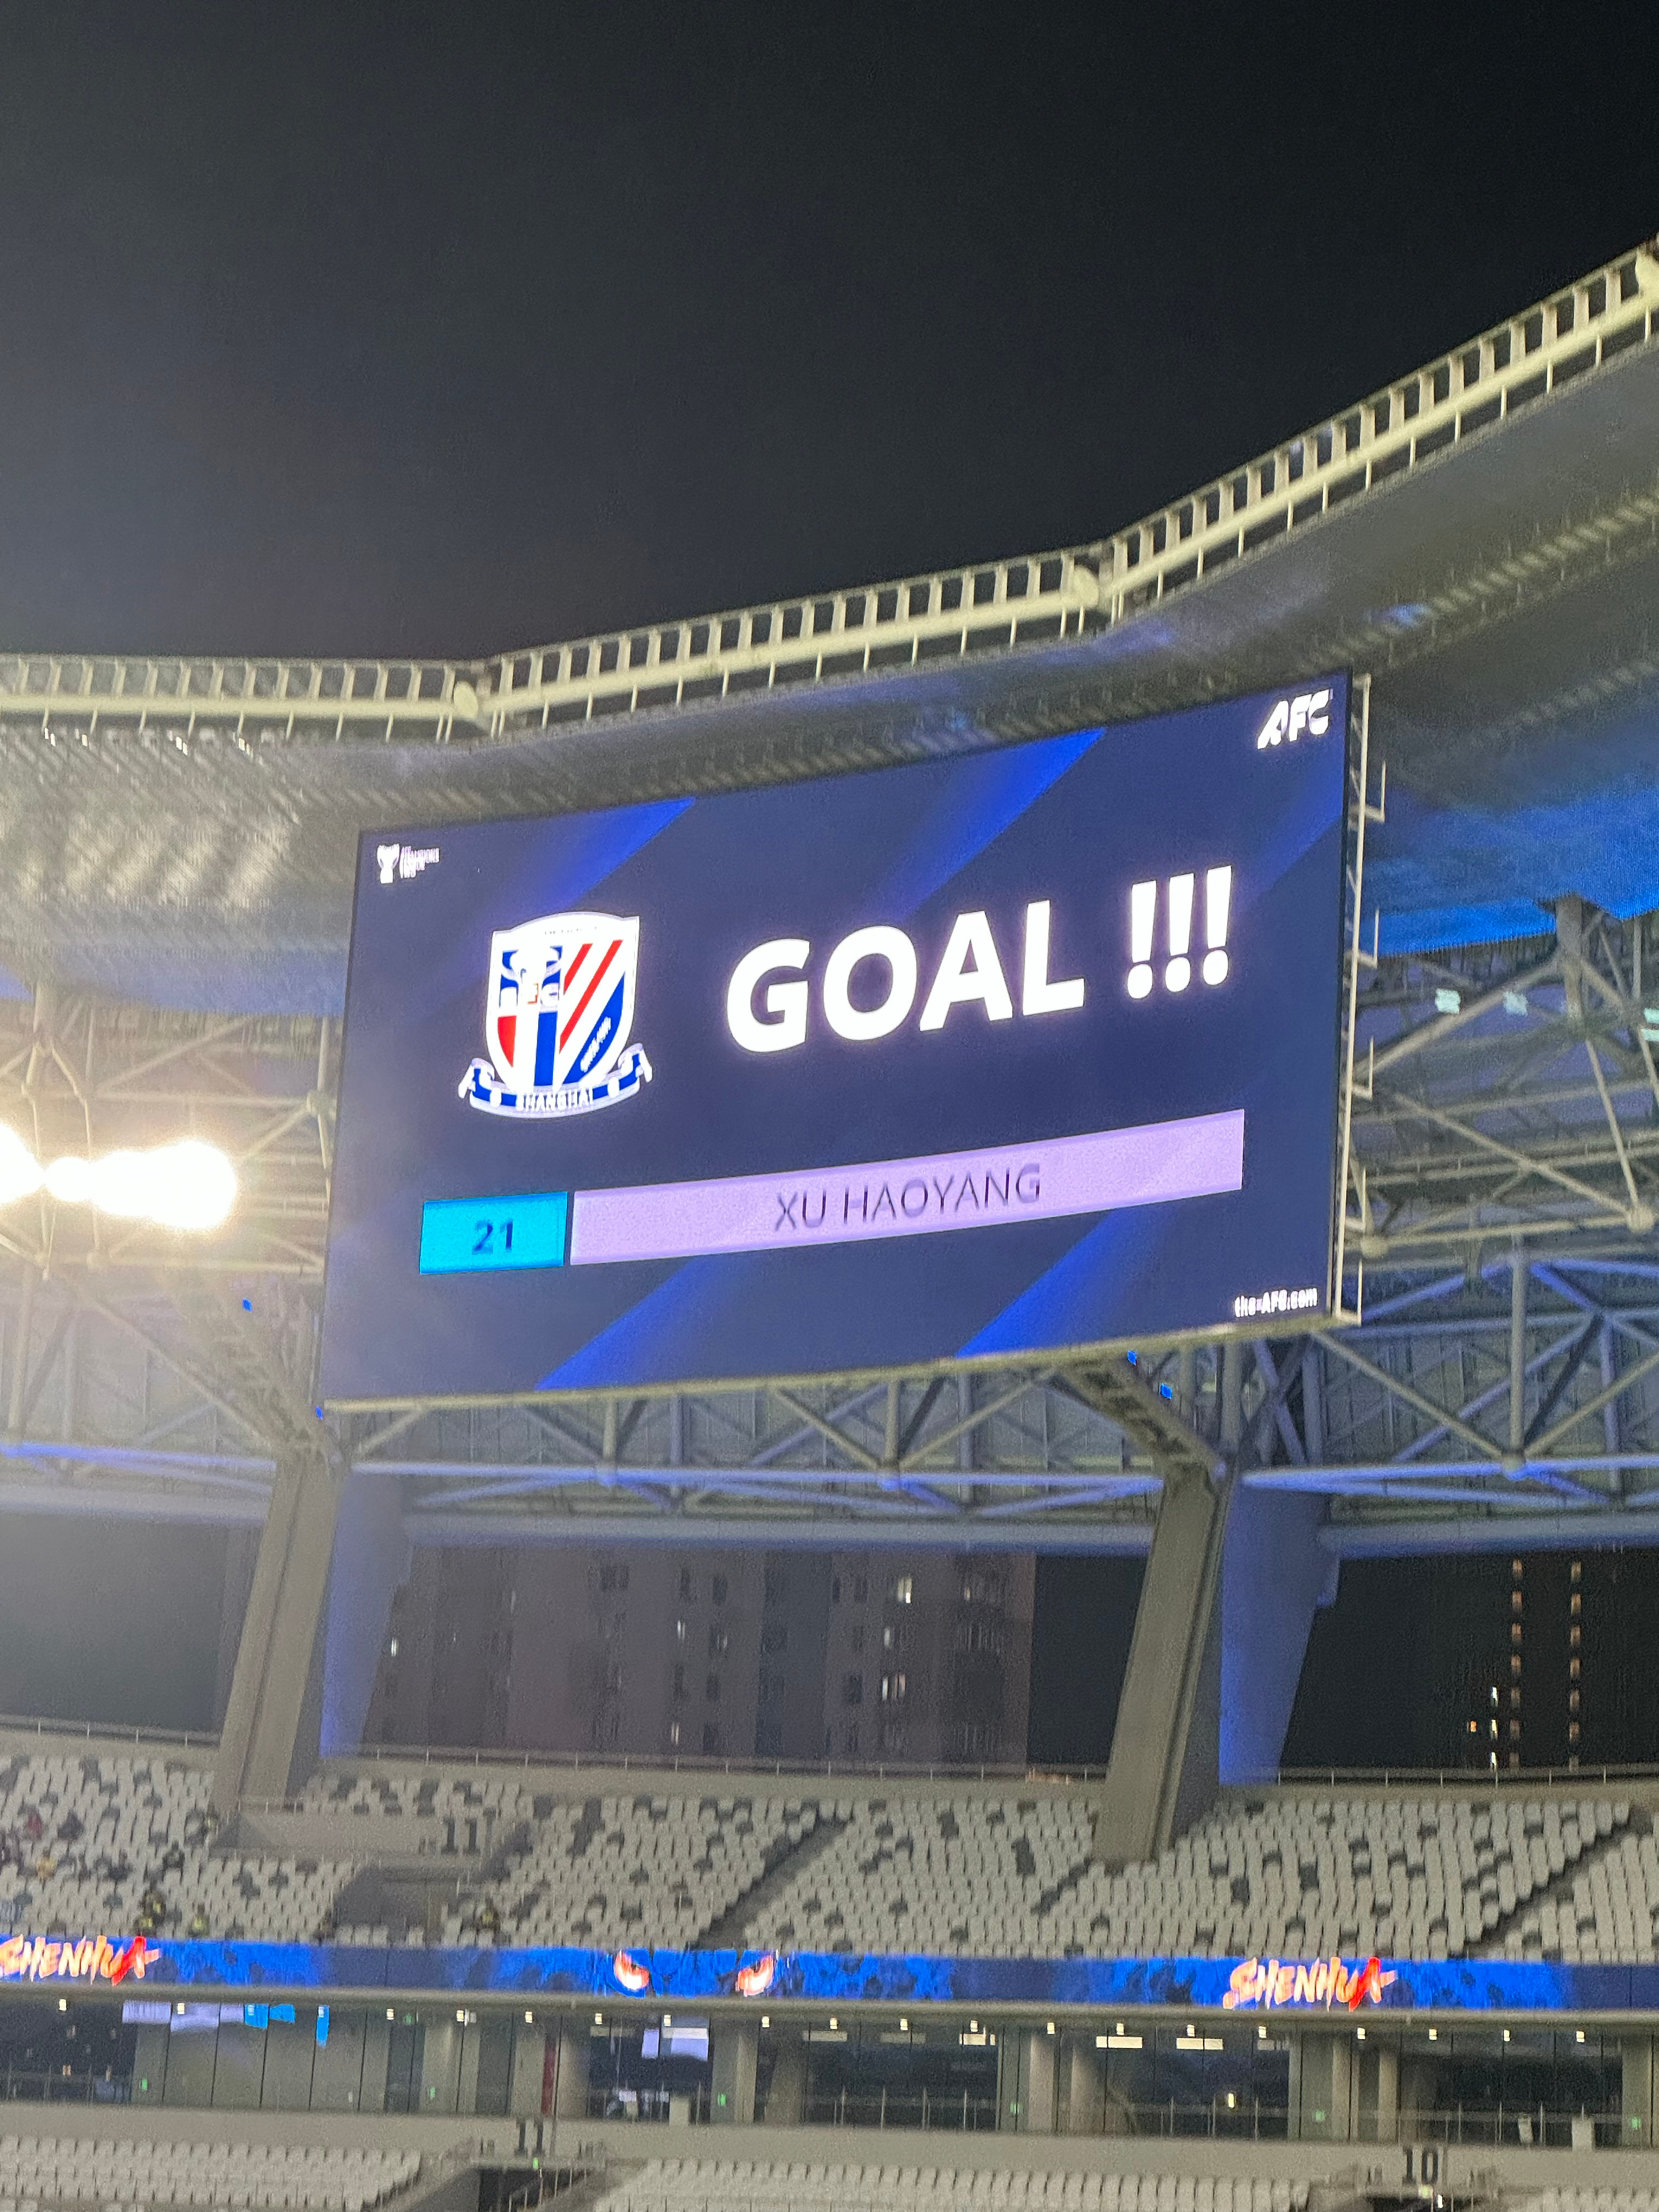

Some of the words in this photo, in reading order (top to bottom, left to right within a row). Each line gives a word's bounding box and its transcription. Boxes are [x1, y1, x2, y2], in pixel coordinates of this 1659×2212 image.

[1257, 689, 1334, 750] AFC
[726, 900, 1085, 1052] GOAL
[1127, 865, 1232, 999] !!!
[516, 1087, 594, 1112] SHANGHAI
[775, 1189, 827, 1231] XU
[843, 1164, 1040, 1225] HAOYANG
[472, 1217, 514, 1255] 21
[441, 1816, 481, 1855] 11
[514, 2117, 544, 2157] 11
[1402, 2145, 1438, 2185] 10
